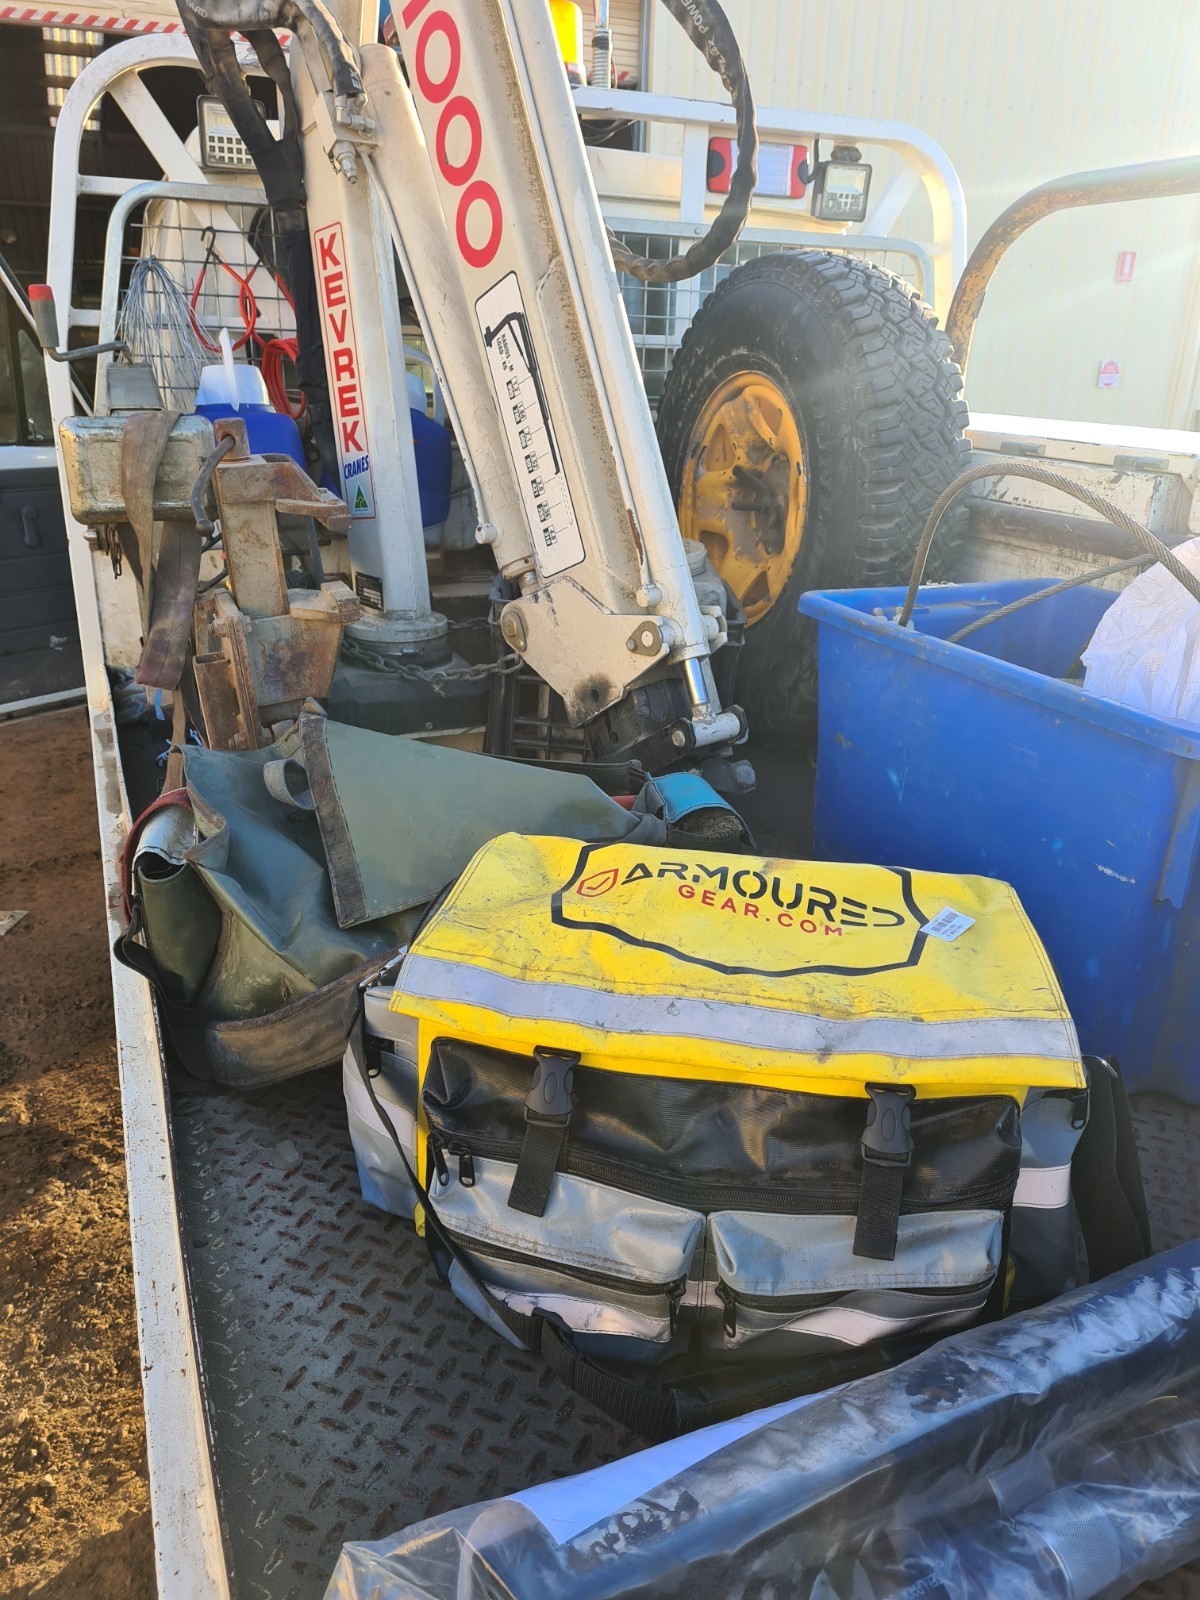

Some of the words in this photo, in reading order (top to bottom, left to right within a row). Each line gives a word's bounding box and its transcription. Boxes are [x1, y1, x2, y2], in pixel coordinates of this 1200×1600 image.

[319, 232, 364, 454] KEVREK
[496, 337, 504, 355] LOAD
[500, 333, 511, 360] RADIUS
[344, 455, 369, 480] CRANES
[621, 862, 906, 928] ARMOURED
[678, 884, 843, 937] GEAR.COM
